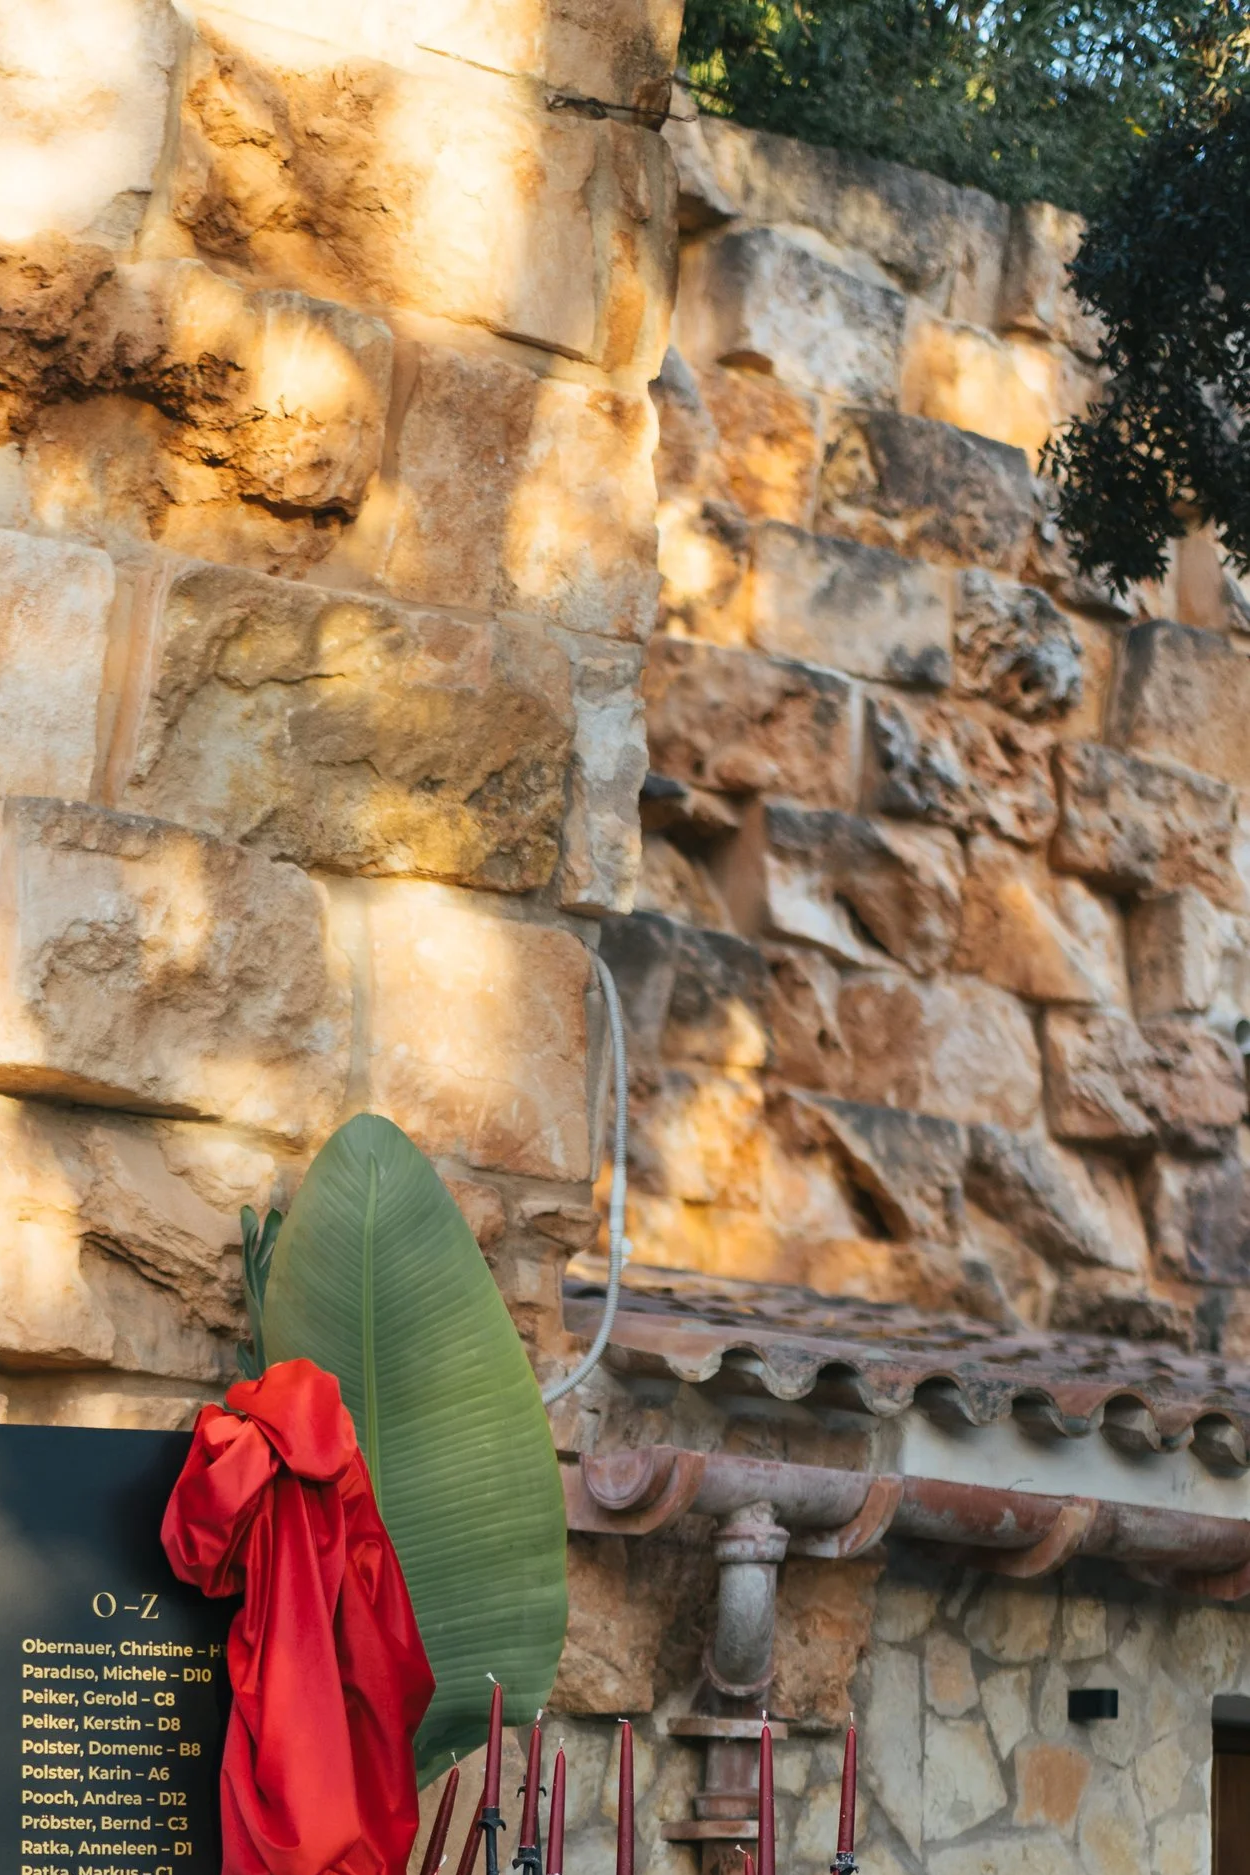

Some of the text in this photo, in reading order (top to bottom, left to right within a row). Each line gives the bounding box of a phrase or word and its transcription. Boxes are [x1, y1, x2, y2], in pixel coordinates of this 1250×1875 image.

[92, 1592, 117, 1618] O
[22, 1764, 84, 1782] Polster,
[89, 1765, 132, 1780] Karin
[148, 1767, 170, 1781] A6
[22, 1814, 97, 1833] Pröbster,
[101, 1816, 151, 1830] Bernd
[167, 1817, 188, 1831] C3
